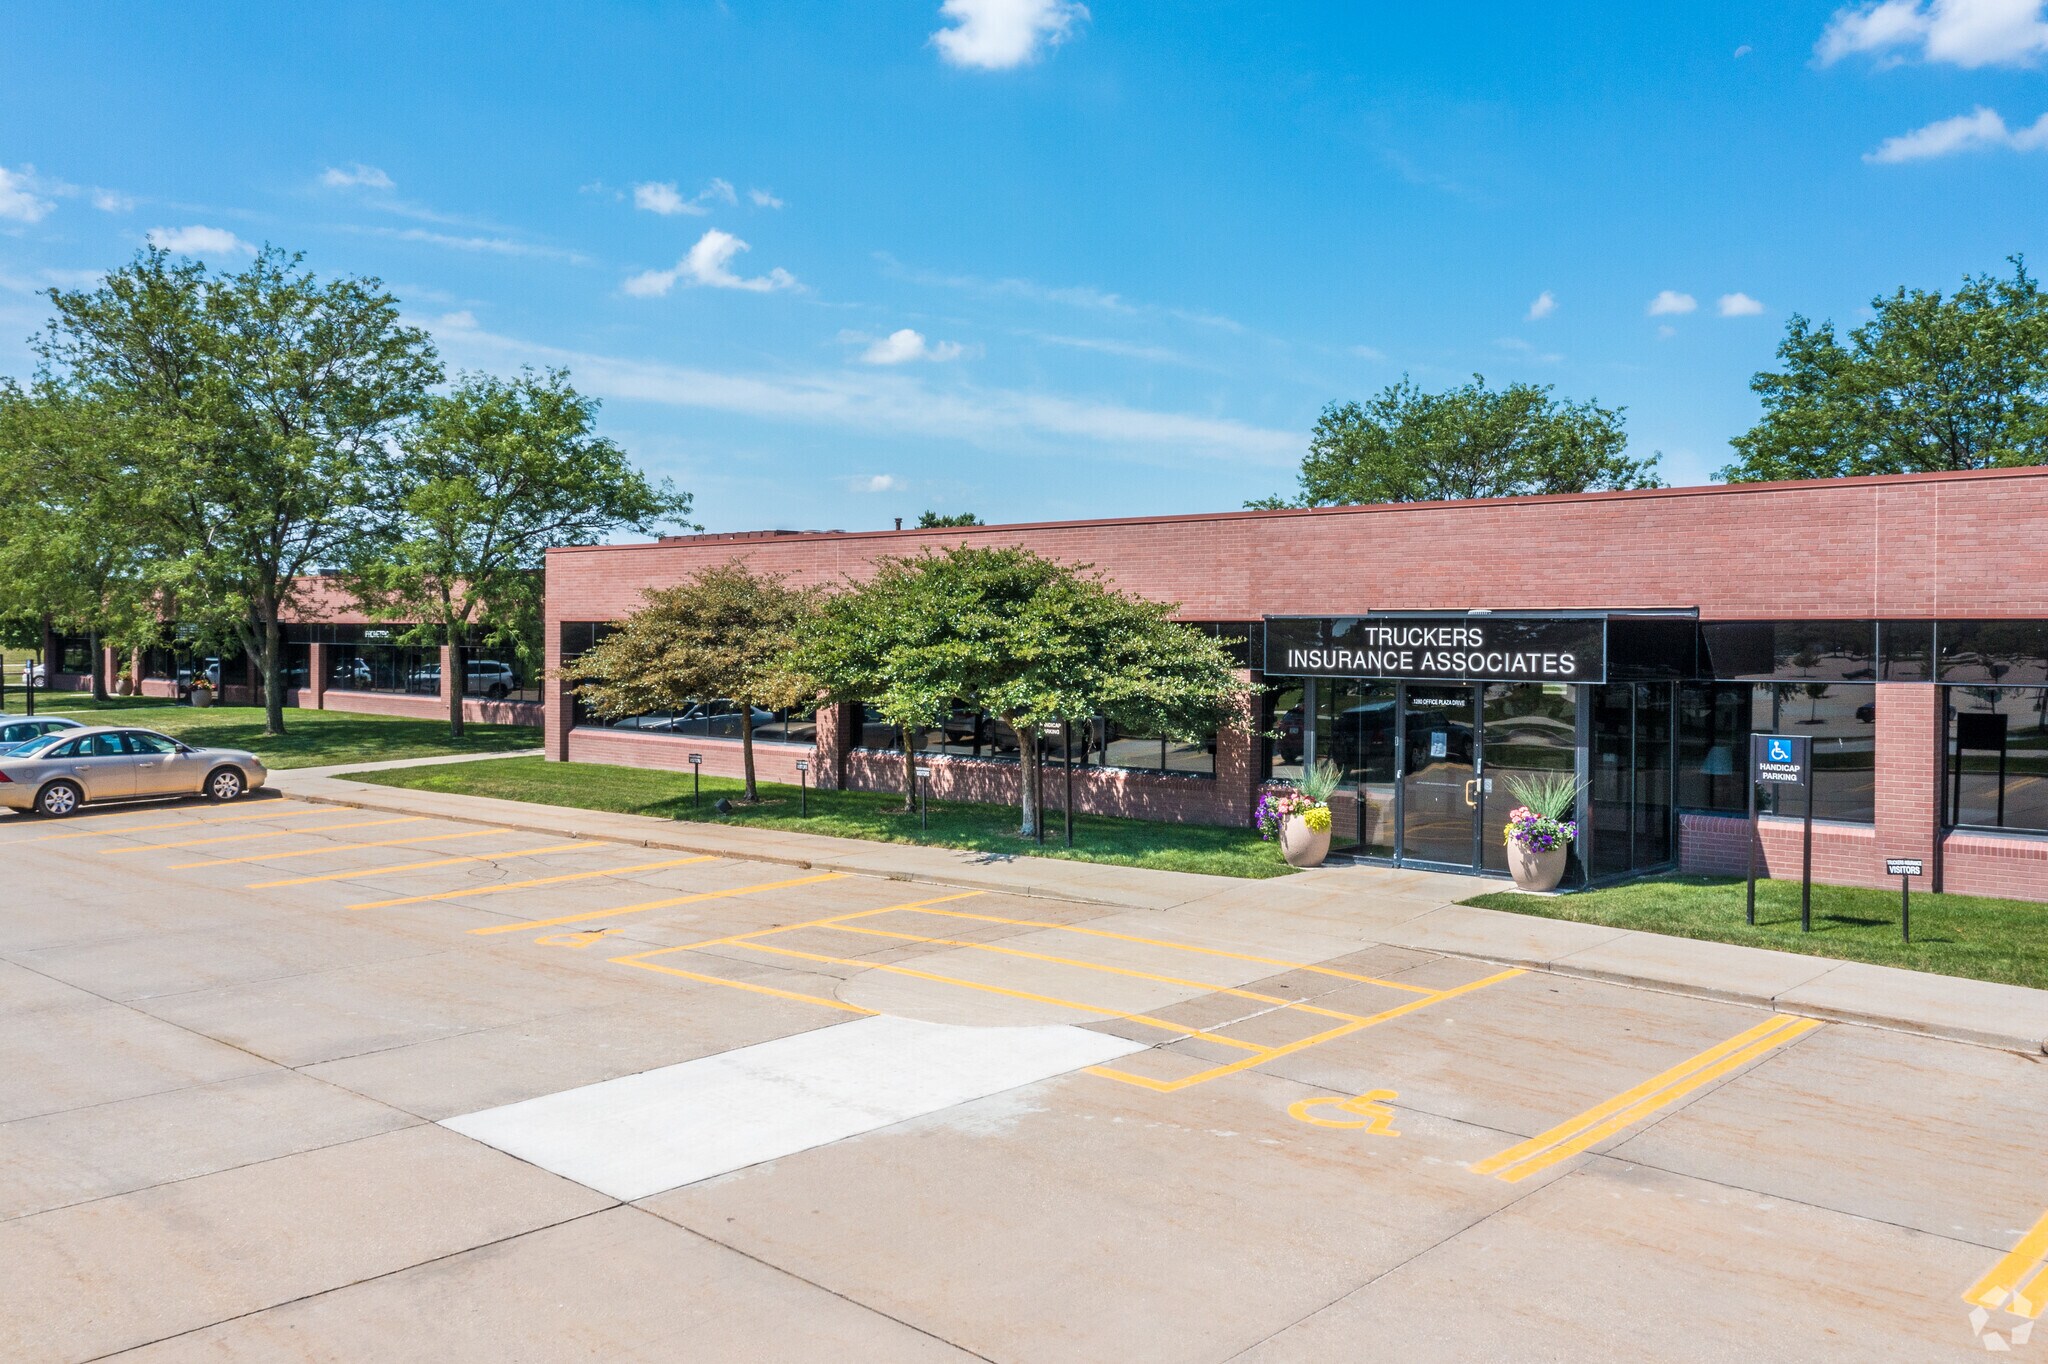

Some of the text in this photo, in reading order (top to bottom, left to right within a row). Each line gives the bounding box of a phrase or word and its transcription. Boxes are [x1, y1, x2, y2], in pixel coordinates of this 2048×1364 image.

[1365, 627, 1484, 647] TRUCKERS
[1288, 649, 1576, 675] INSURANCE ASSOCIATES
[1759, 763, 1801, 773] HANDICAP
[1762, 772, 1798, 782] PARKING
[1888, 865, 1921, 875] VISITORS
